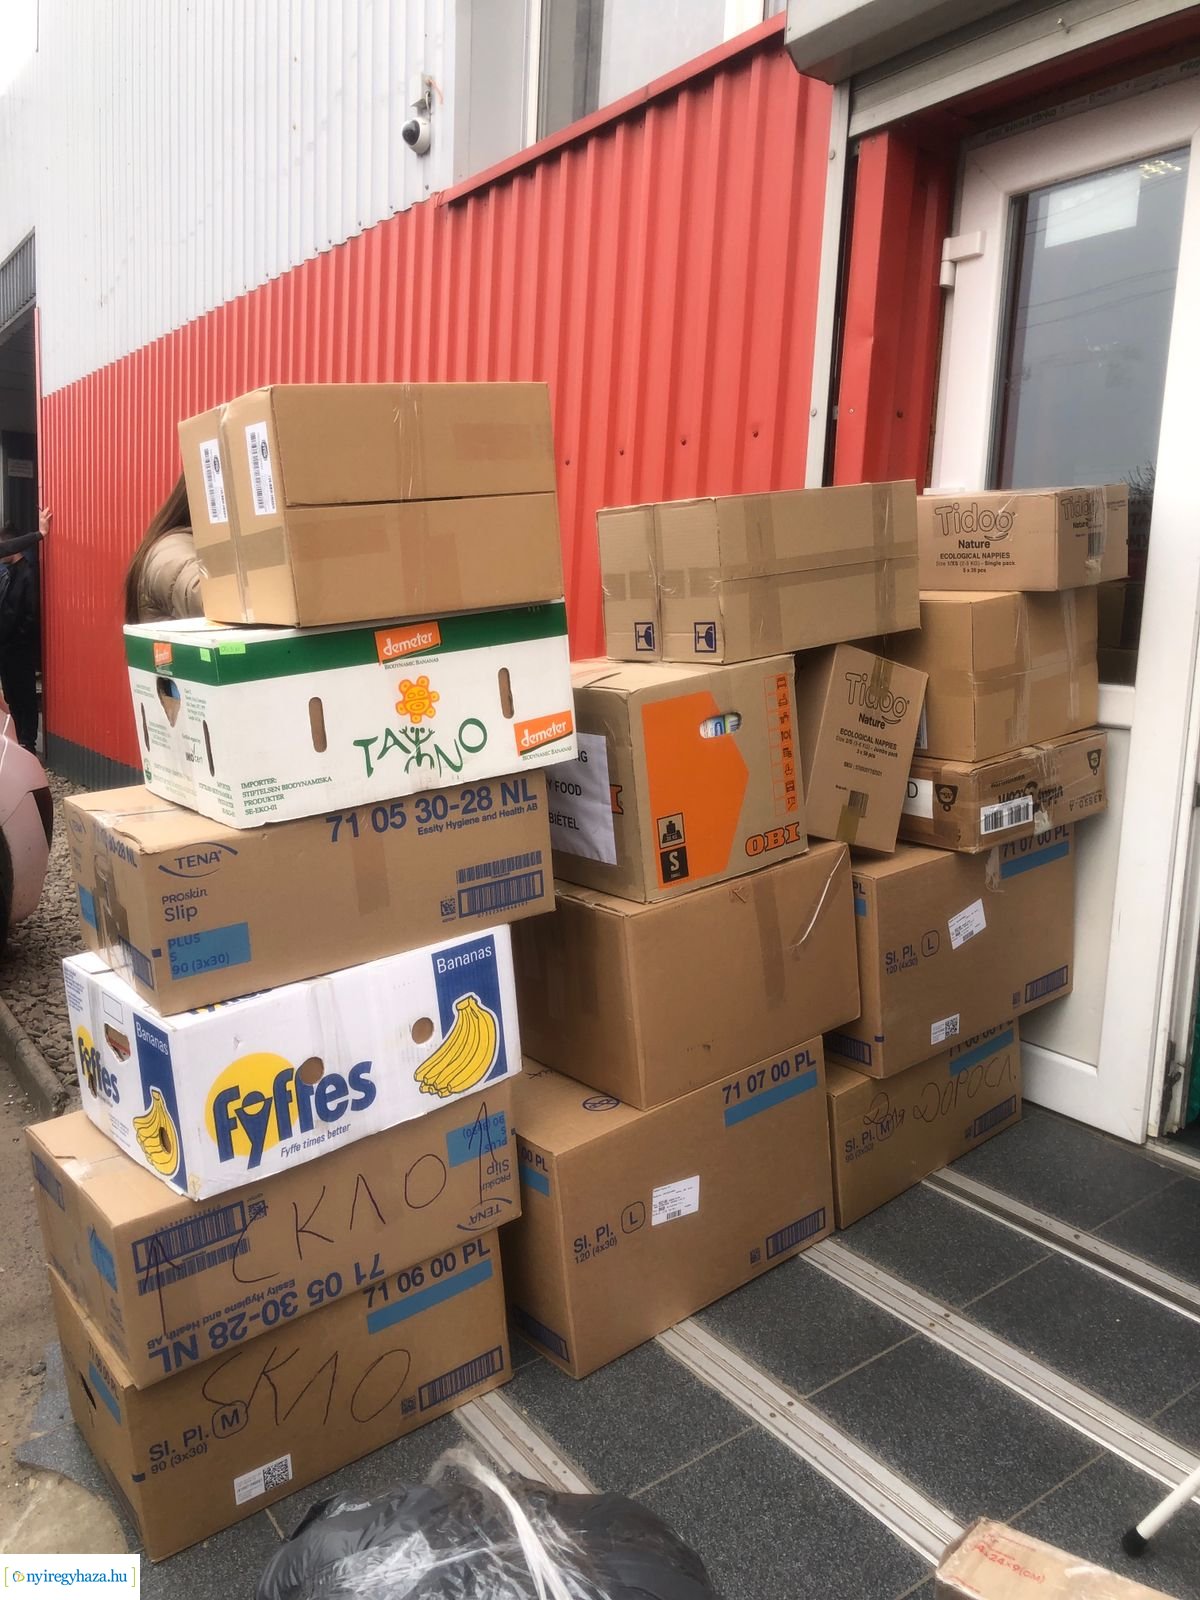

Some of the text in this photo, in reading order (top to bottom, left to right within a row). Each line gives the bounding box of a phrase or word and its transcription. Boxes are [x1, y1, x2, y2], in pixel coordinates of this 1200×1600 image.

[935, 502, 1013, 536] Tidoo
[958, 540, 991, 548] Nature
[383, 631, 433, 656] demeter
[415, 658, 439, 667] BANANAS
[858, 712, 886, 730] Nature
[521, 720, 567, 747] demeter
[840, 728, 897, 750] ECOLOGICAL NAPPIES
[242, 776, 332, 798] STIFTELSEN BIODYNAMISKA
[555, 781, 582, 796] FOOD
[907, 781, 918, 799] D
[244, 794, 285, 807] PRODUKTER
[245, 805, 277, 815] SE-EKO-01
[326, 778, 537, 842] 71 05 30-28 NL
[417, 803, 538, 836] Essity Hygiene and Health AB
[745, 822, 800, 856] OBI
[1055, 824, 1069, 841] PL
[174, 851, 221, 870] TENA
[669, 851, 680, 871] S
[162, 888, 208, 905] PROskin
[165, 905, 198, 922] Slip
[168, 933, 201, 949] PLUS
[928, 939, 935, 950] L
[170, 952, 177, 962] S
[172, 952, 230, 975] 90 (3x30)
[436, 945, 492, 974] Bananas
[886, 964, 898, 975] 120
[136, 1022, 168, 1055] Bananas
[722, 1050, 816, 1104] 71 07 00 PL
[281, 1124, 351, 1158] Fyffe times better
[486, 1159, 509, 1176] Slip
[535, 1153, 549, 1173] PL
[470, 1204, 502, 1224] TENA
[629, 1212, 638, 1225] L
[575, 1236, 617, 1264] 120 (4x30)
[363, 1239, 490, 1308] 71 06 00 PL
[147, 1279, 295, 1350] Essity Hygiene and Health AB
[149, 1253, 385, 1373] 71 05 30-28 NL
[221, 1409, 240, 1429] M
[151, 1443, 208, 1475] 90 (3x30)
